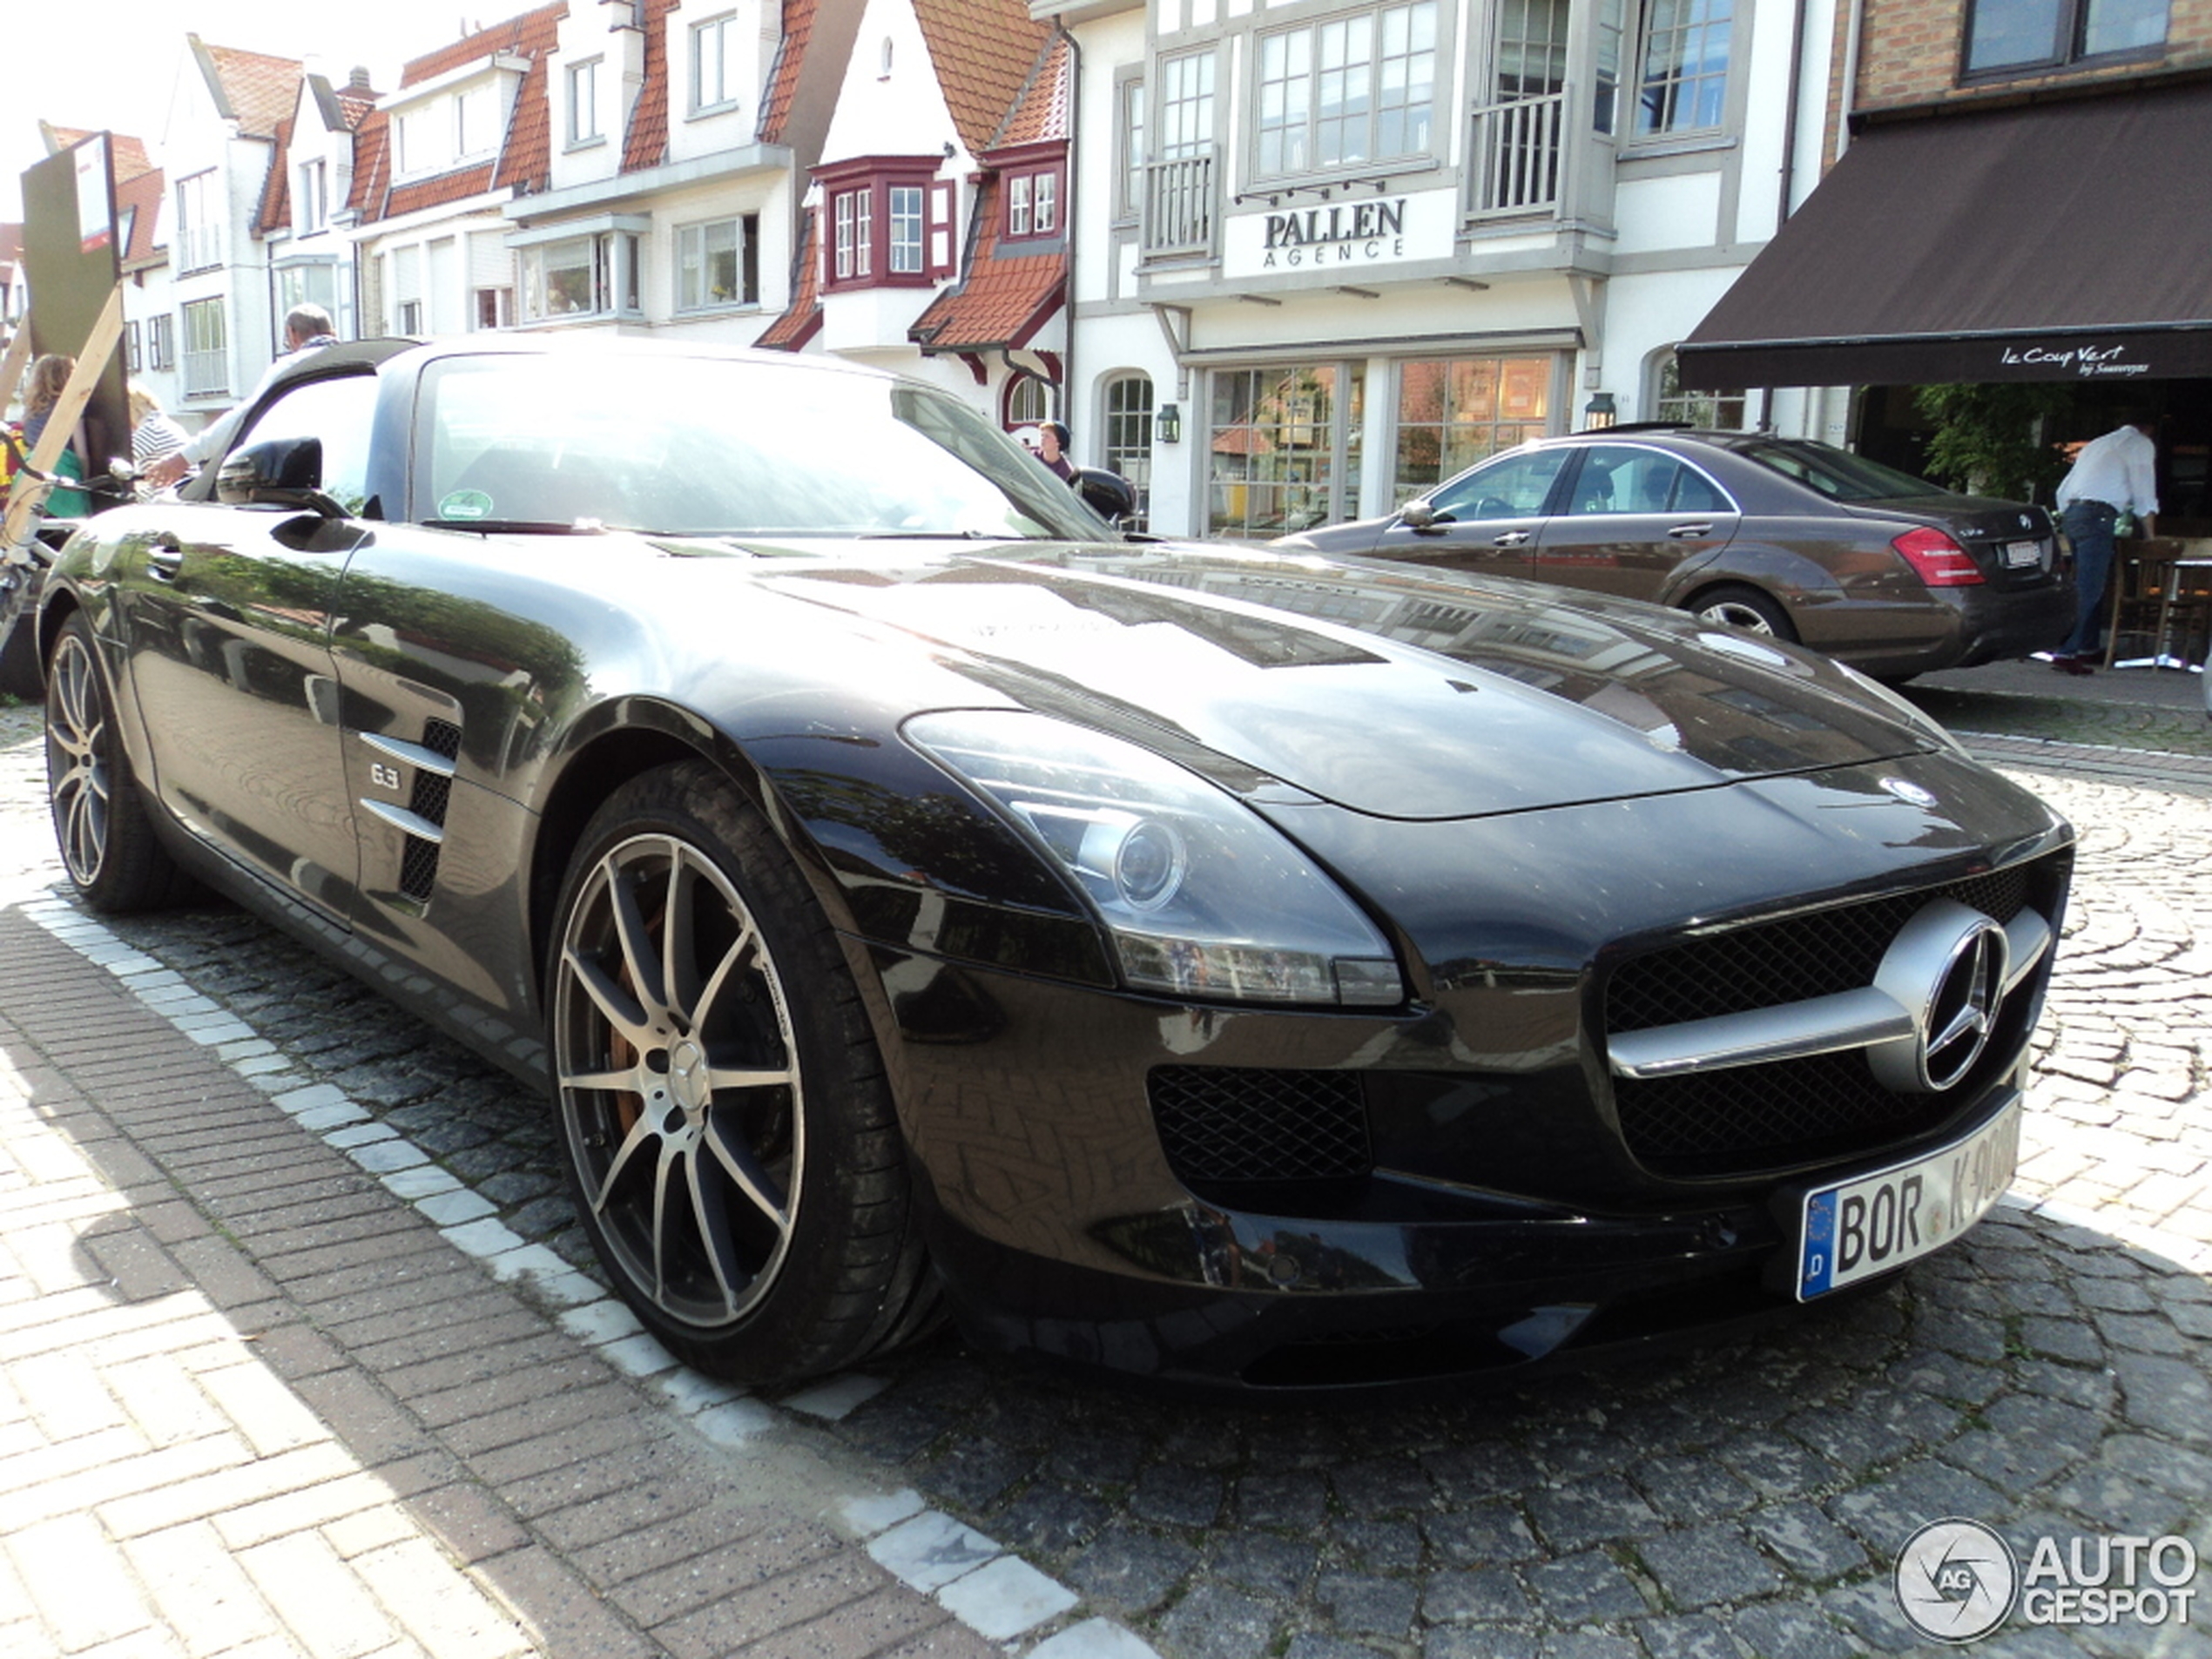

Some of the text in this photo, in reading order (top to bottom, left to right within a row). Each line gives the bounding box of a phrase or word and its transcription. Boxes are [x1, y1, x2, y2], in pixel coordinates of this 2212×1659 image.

[1263, 199, 1406, 249] PALLEN
[1264, 239, 1404, 268] AGENCE
[2023, 347, 2074, 368] Coup
[2077, 345, 2125, 361] Vert
[370, 763, 401, 790] 63
[1810, 1254, 1824, 1276] D
[1838, 1174, 1923, 1273] BOR
